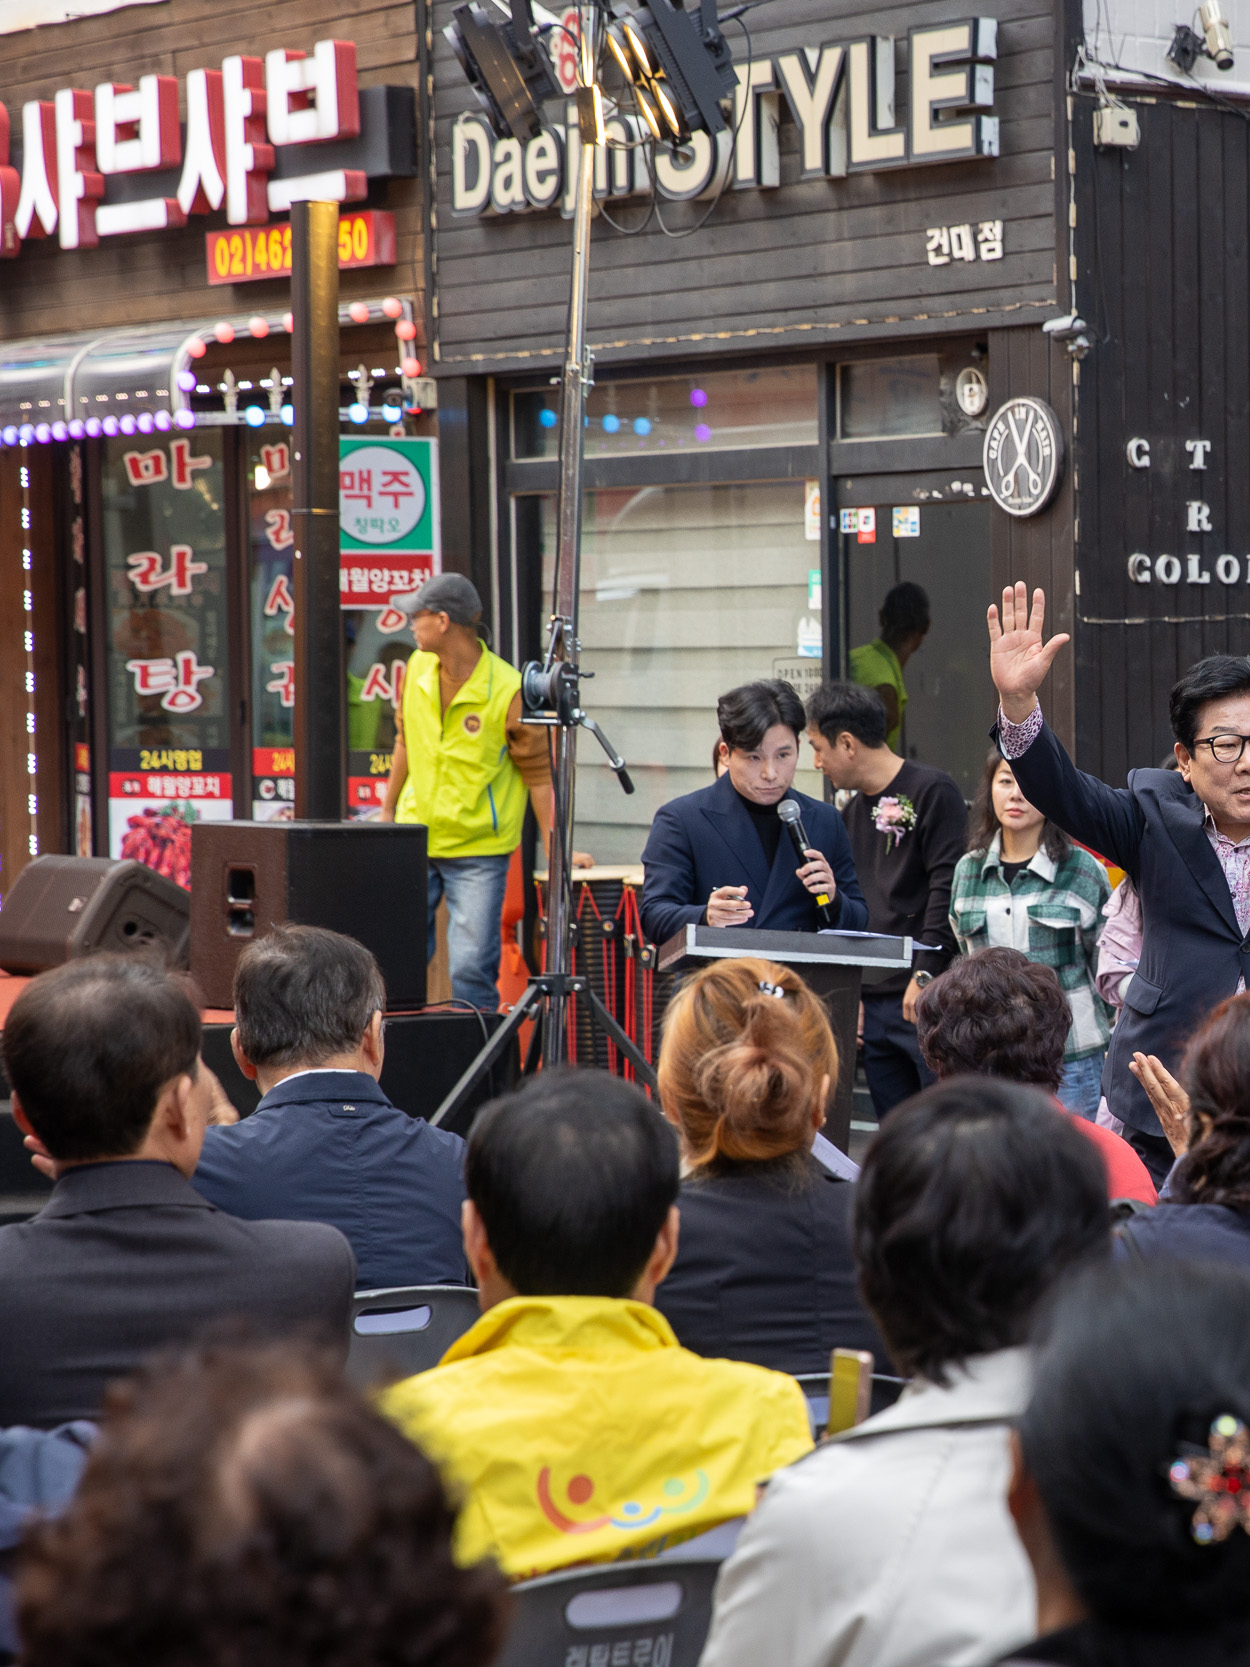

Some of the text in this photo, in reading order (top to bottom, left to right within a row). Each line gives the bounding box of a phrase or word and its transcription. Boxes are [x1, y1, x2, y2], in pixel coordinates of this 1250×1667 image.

[14, 38, 350, 250] 샤브샤브
[925, 219, 1004, 266] 건대점
[1184, 438, 1212, 470] T
[339, 468, 416, 511] 맥주
[1185, 501, 1213, 532] R
